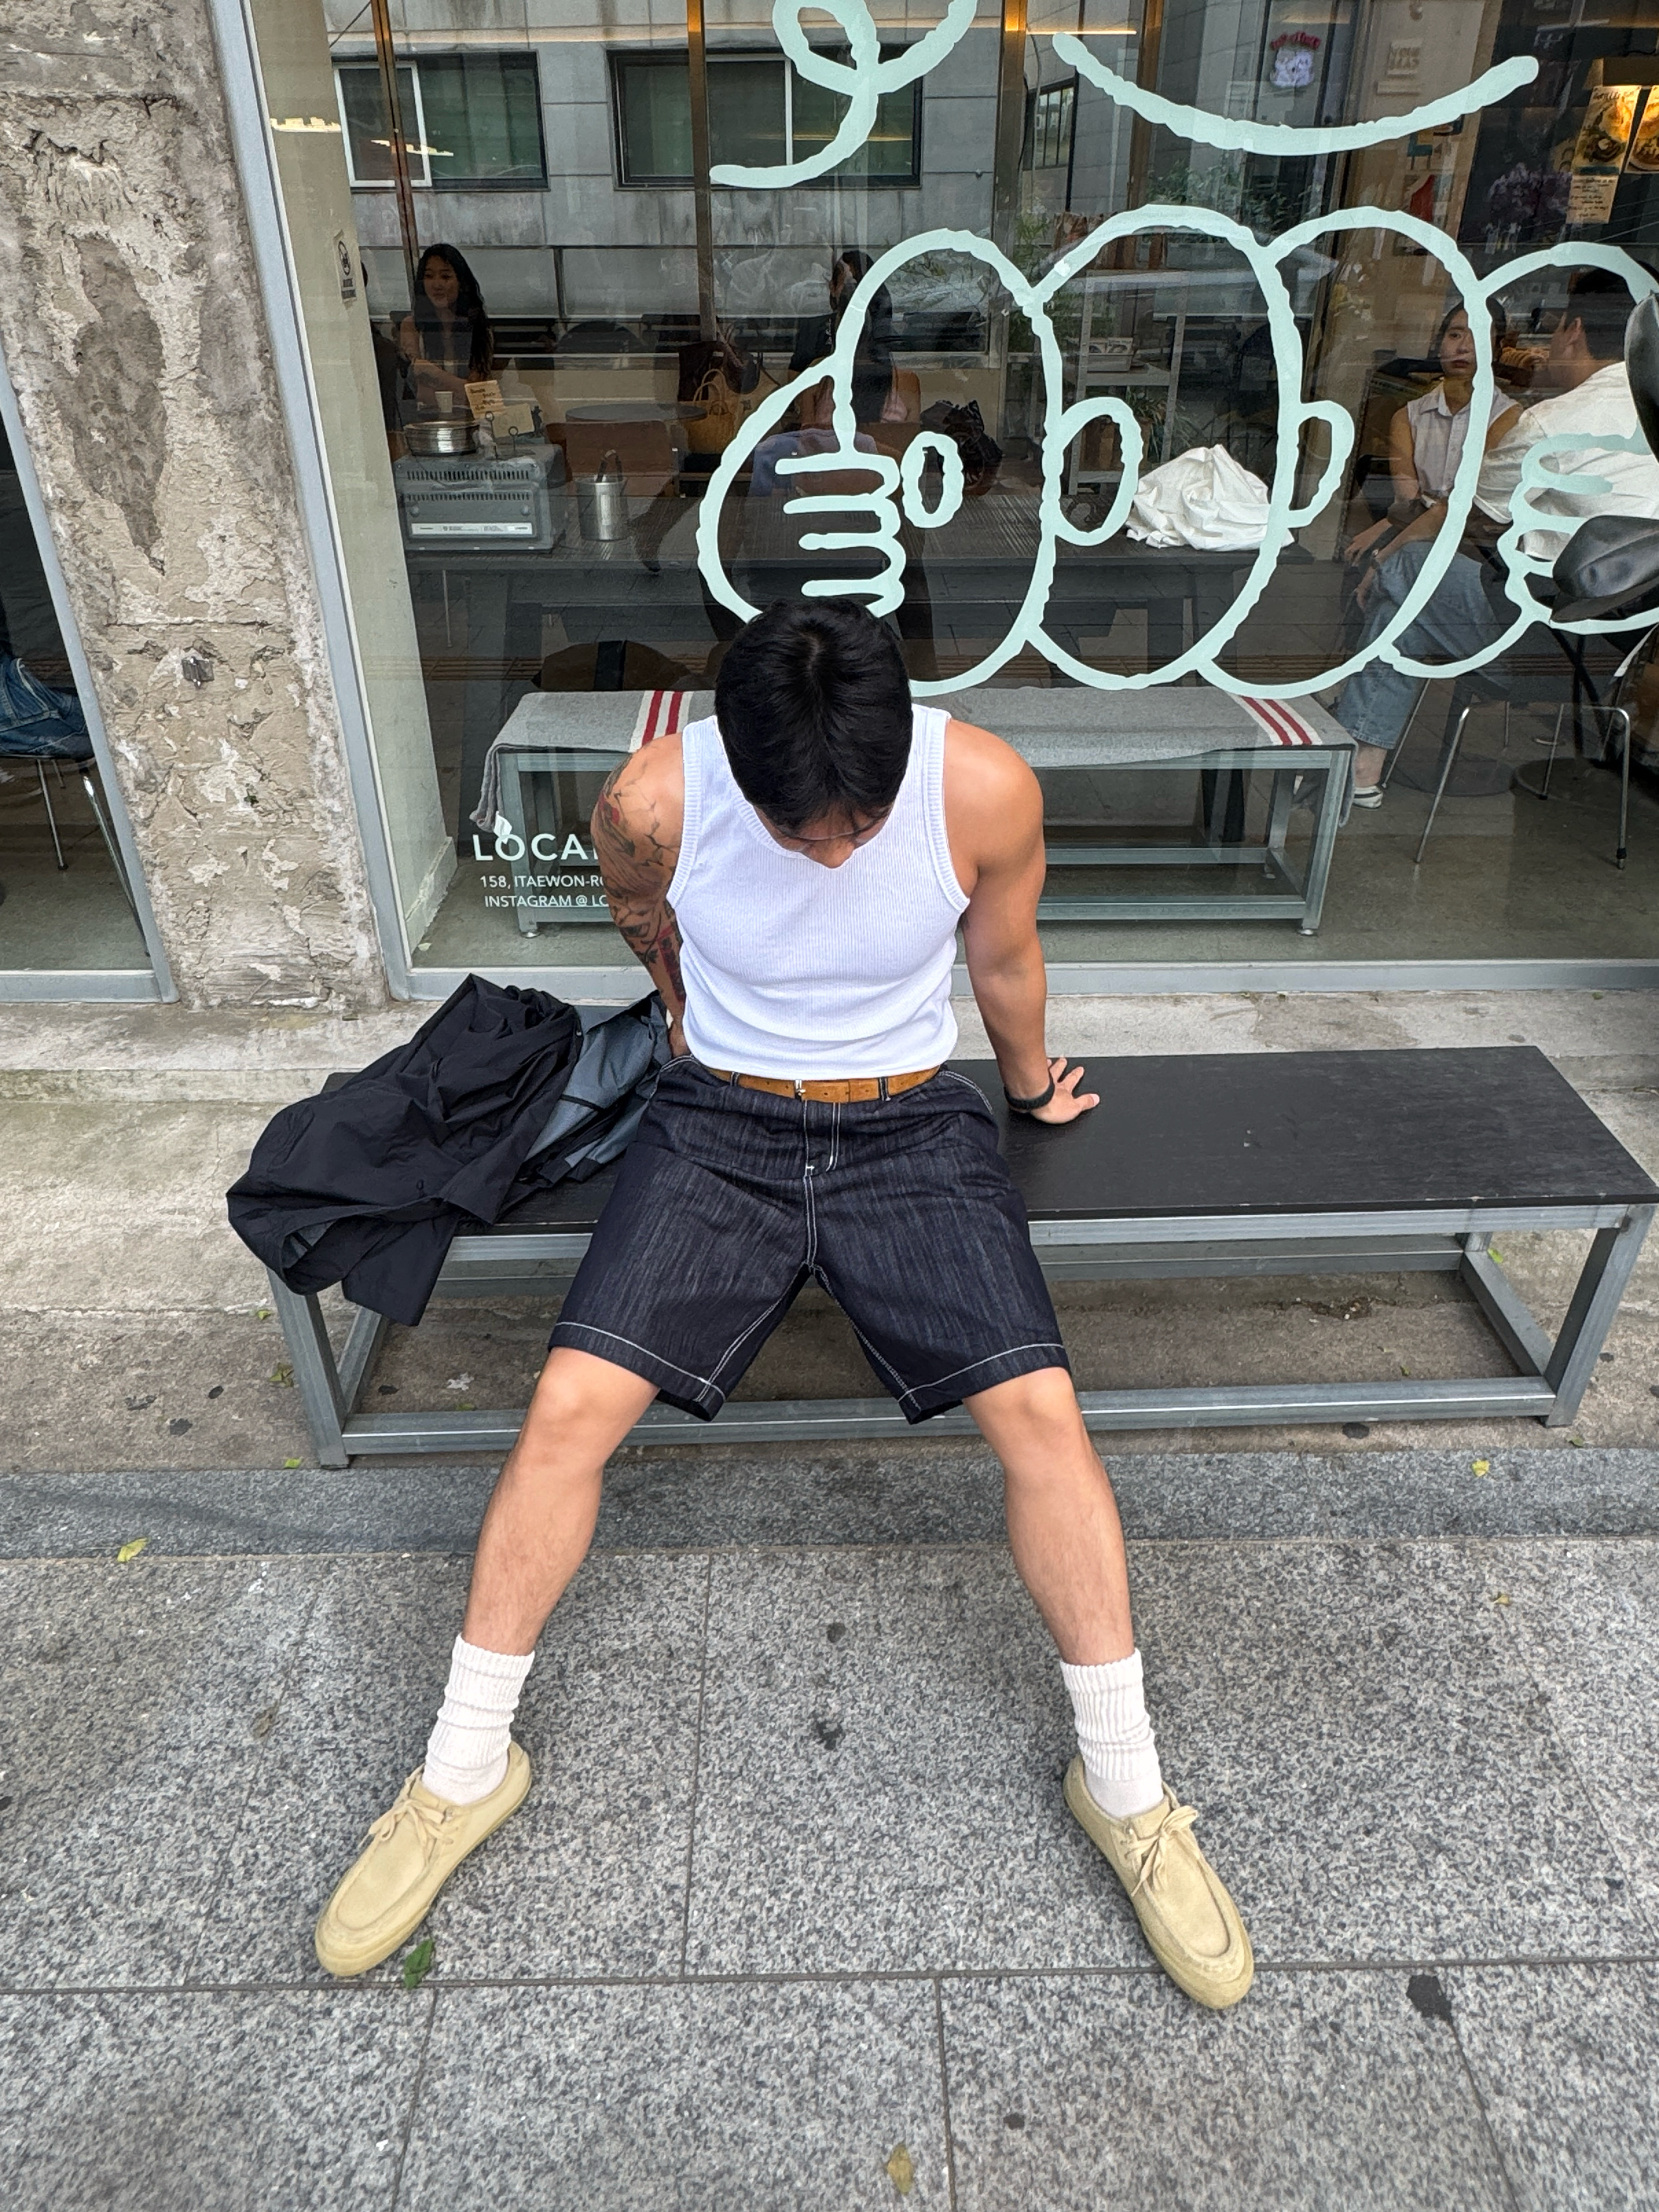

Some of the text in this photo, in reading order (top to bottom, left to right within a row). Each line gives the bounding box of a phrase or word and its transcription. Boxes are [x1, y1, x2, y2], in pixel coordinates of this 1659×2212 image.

[473, 834, 599, 861] LOCA
[480, 875, 511, 889] 158,
[485, 895, 571, 907] INSTAGRAM
[576, 895, 588, 906] @
